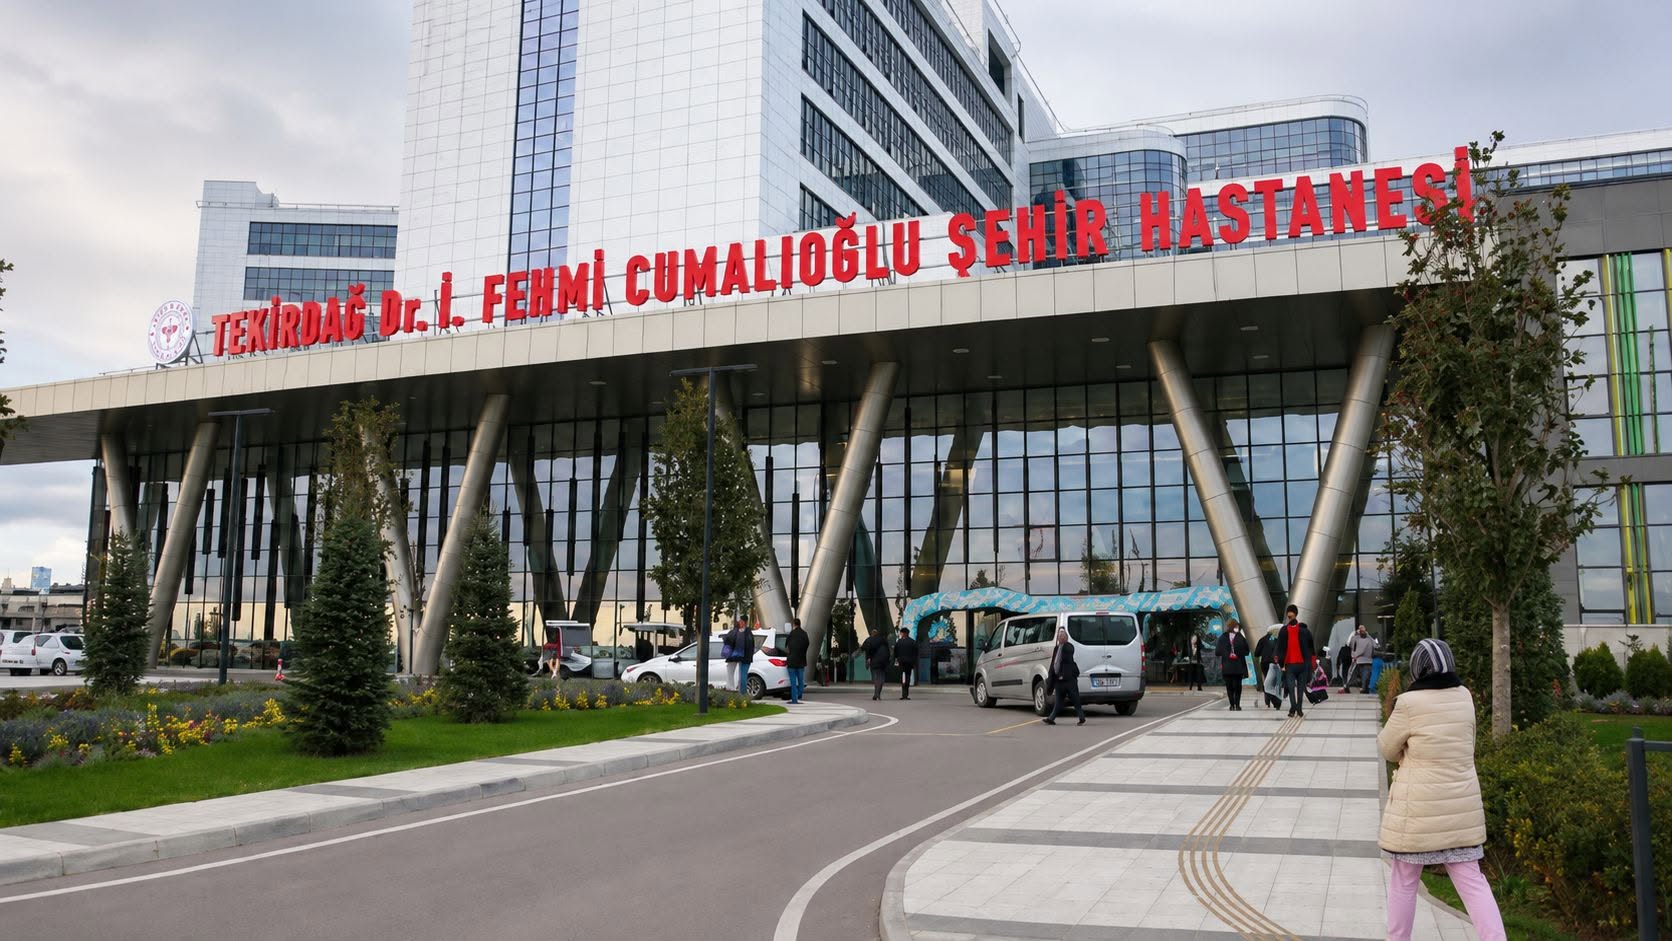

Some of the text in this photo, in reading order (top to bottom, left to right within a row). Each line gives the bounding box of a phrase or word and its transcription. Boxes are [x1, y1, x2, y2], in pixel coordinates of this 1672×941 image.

[212, 283, 367, 357] TEKİRDAĞ
[380, 290, 428, 337] Dr.
[438, 272, 465, 329] İ.
[482, 249, 611, 324] FEHMİ
[625, 212, 921, 307] CUMALIOĞLU
[948, 190, 1109, 278] ŞEHİR
[1140, 146, 1475, 251] HASTANESİ
